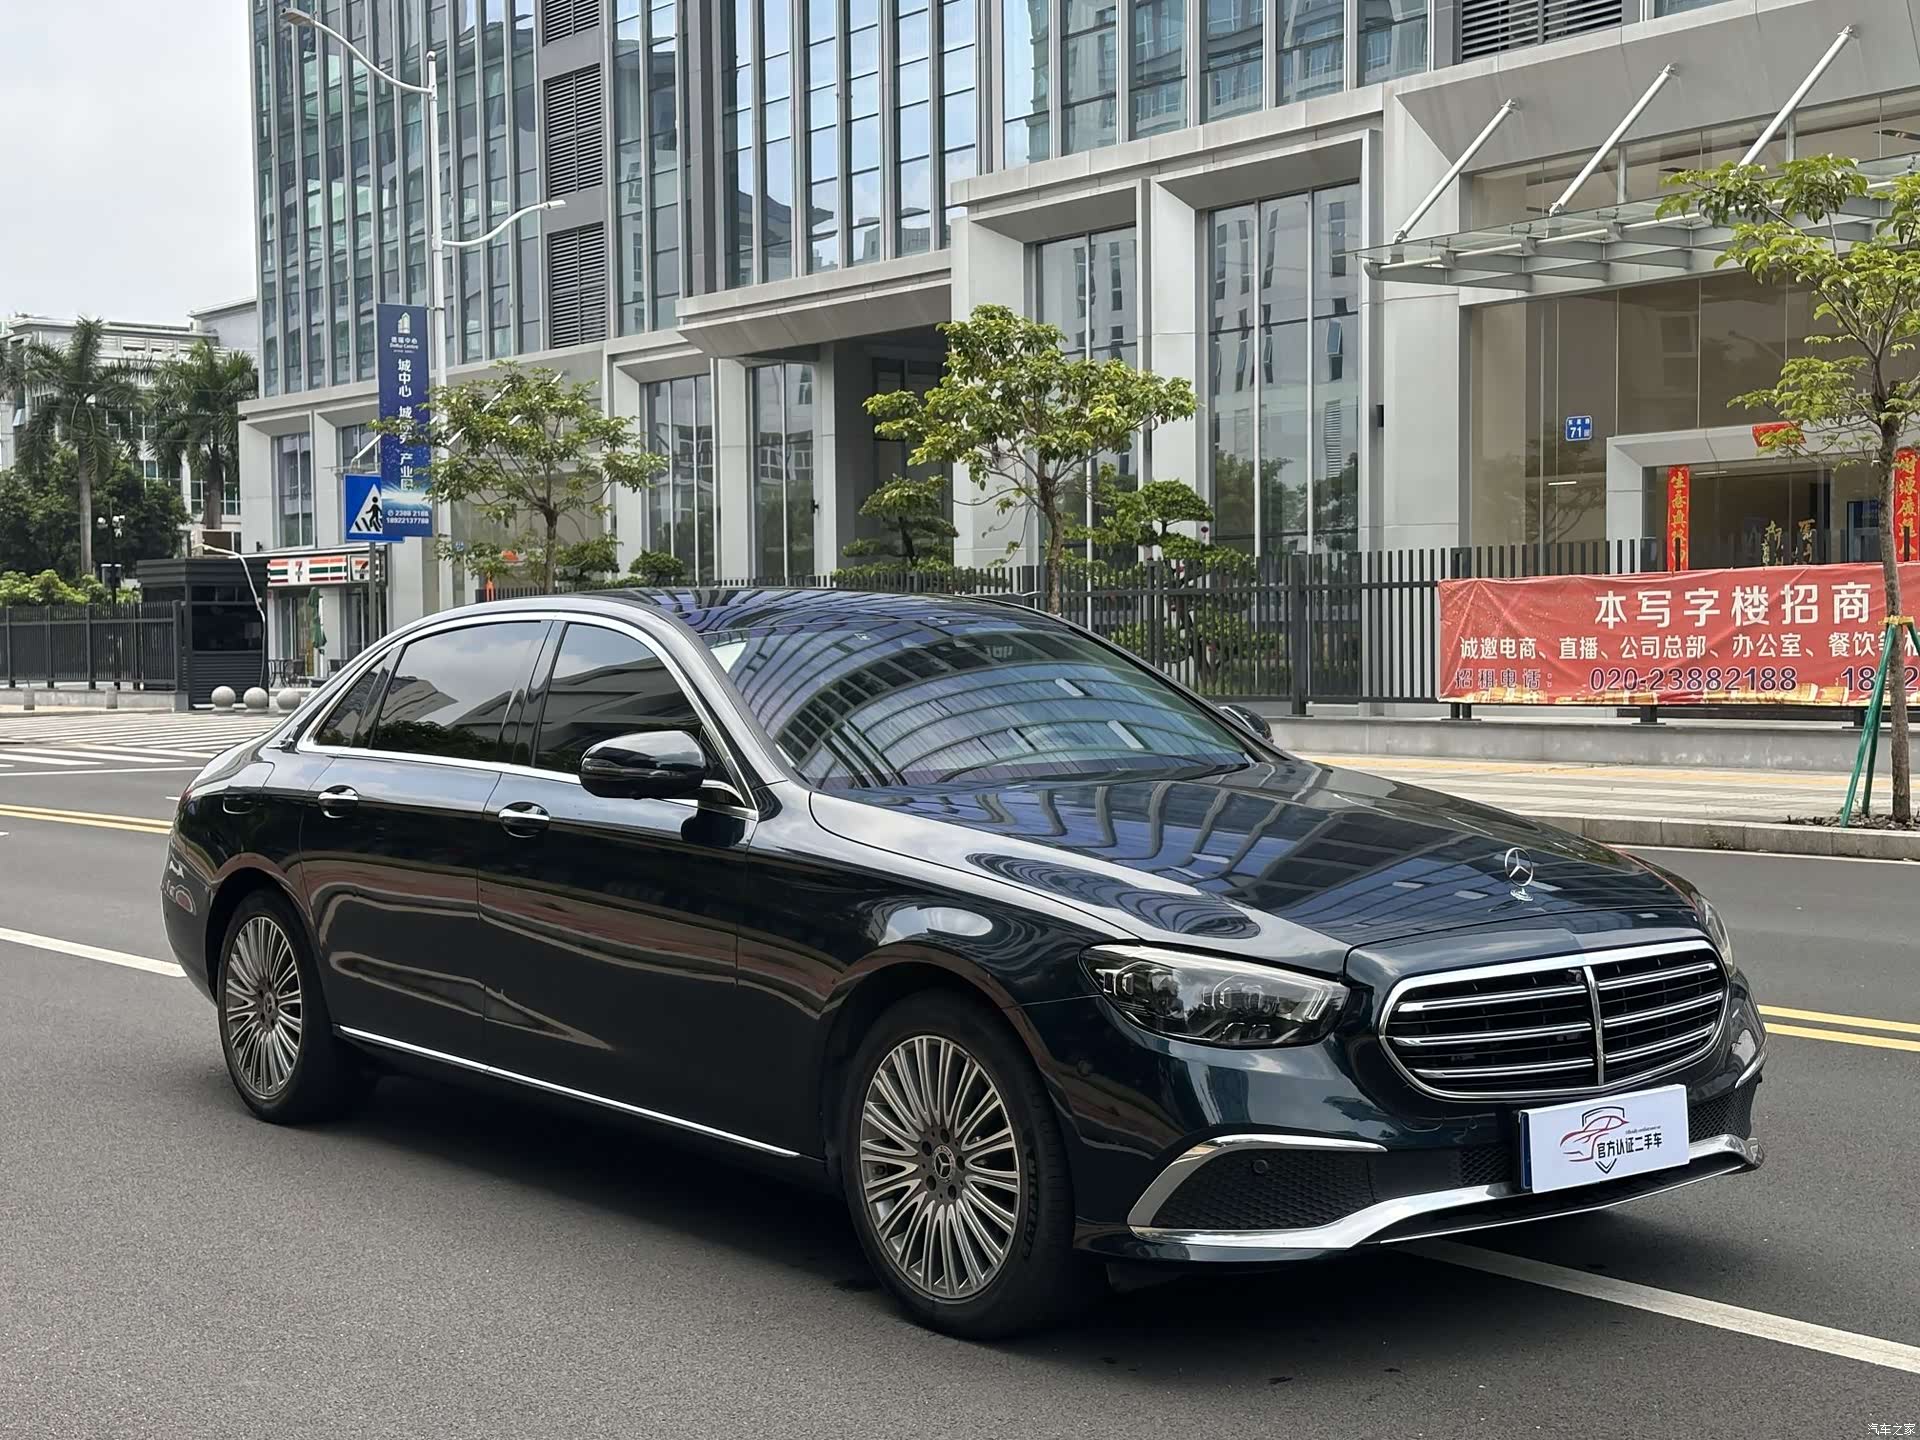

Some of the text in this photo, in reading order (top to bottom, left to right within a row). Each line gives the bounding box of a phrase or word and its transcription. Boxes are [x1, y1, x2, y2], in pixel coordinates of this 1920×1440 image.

[398, 358, 412, 397] 城中心
[1570, 426, 1582, 438] 71
[400, 453, 413, 491] 产业园
[1595, 582, 1872, 630] 本写字楼招商
[1589, 665, 1798, 692] 020-23882188
[1597, 1132, 1663, 1159] 官方认证二手车
